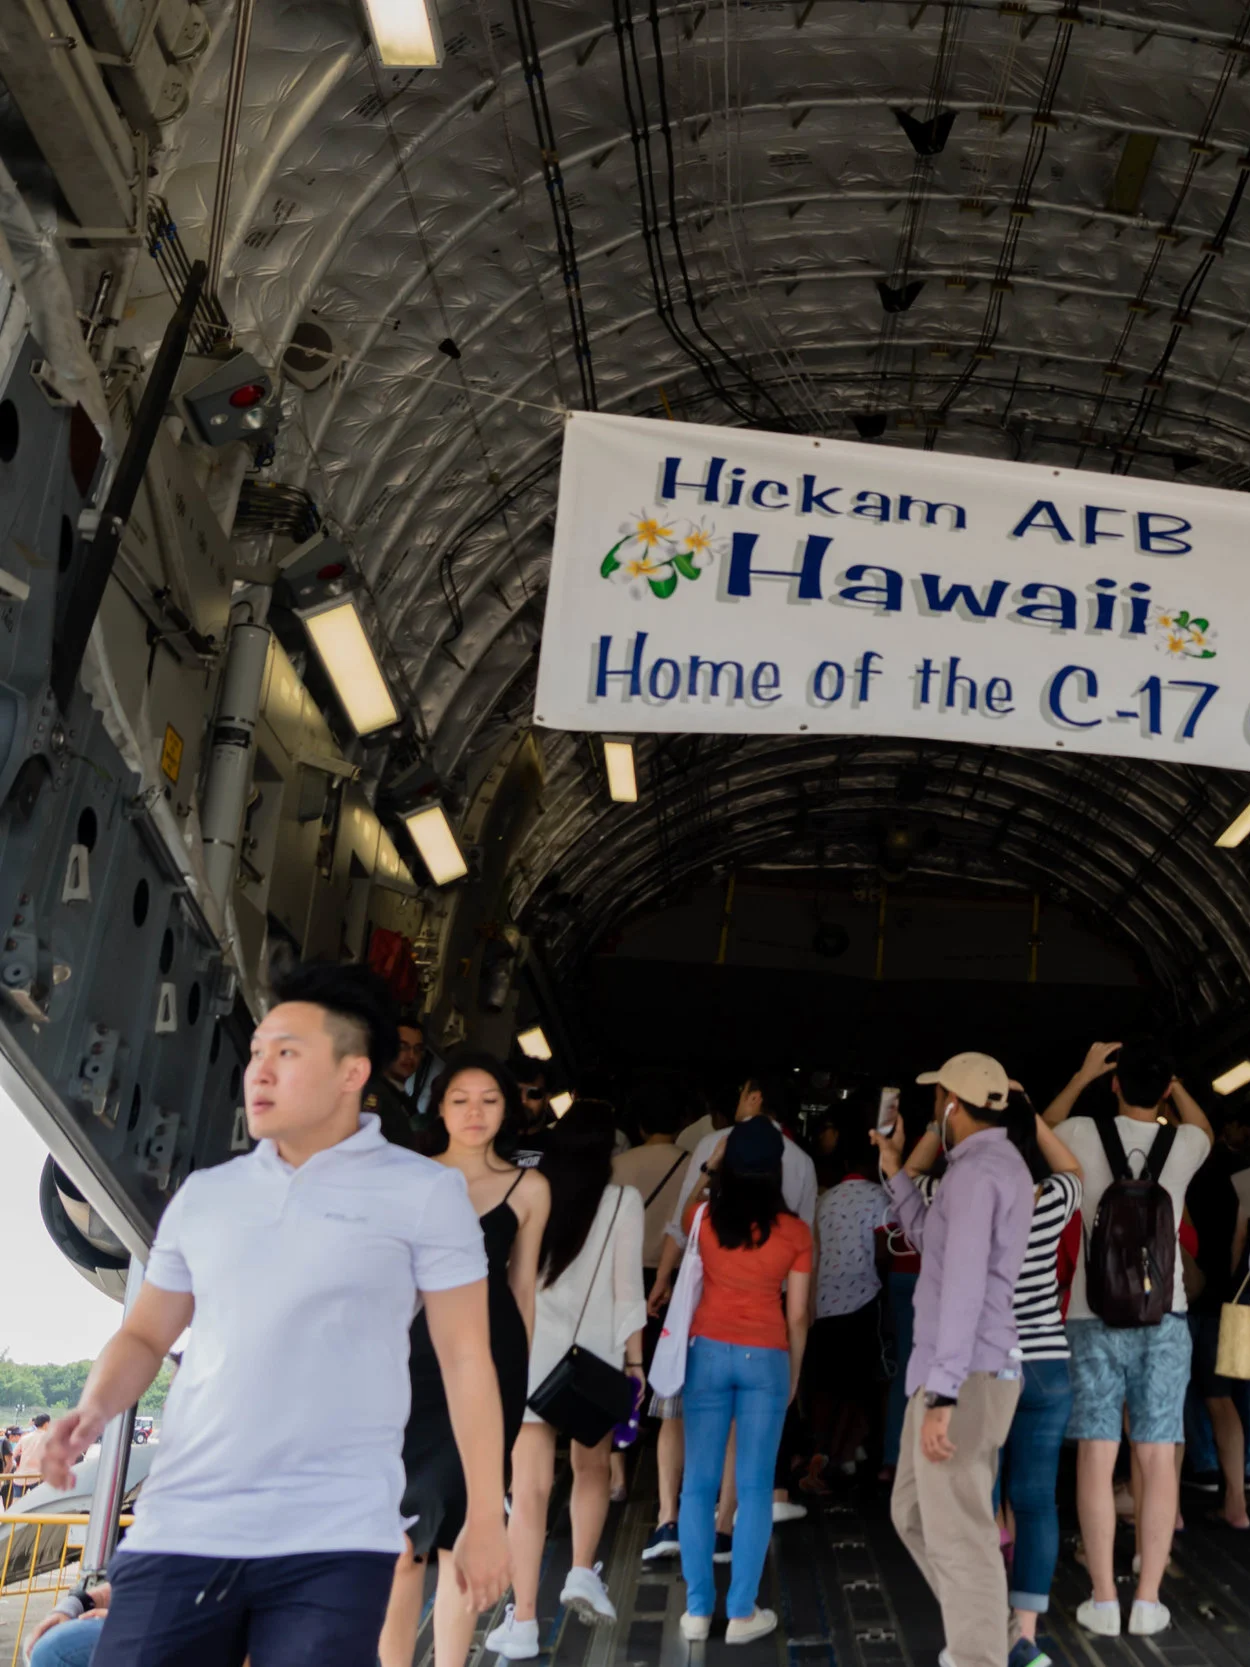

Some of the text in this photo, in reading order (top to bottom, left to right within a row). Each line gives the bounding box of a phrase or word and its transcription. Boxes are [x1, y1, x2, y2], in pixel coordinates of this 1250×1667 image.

[660, 457, 1193, 555] Hickam AFB
[726, 532, 1152, 635] Hawaii
[594, 631, 781, 701] Home
[812, 650, 883, 703] of
[915, 656, 1015, 714] the
[1047, 664, 1219, 739] C-17
